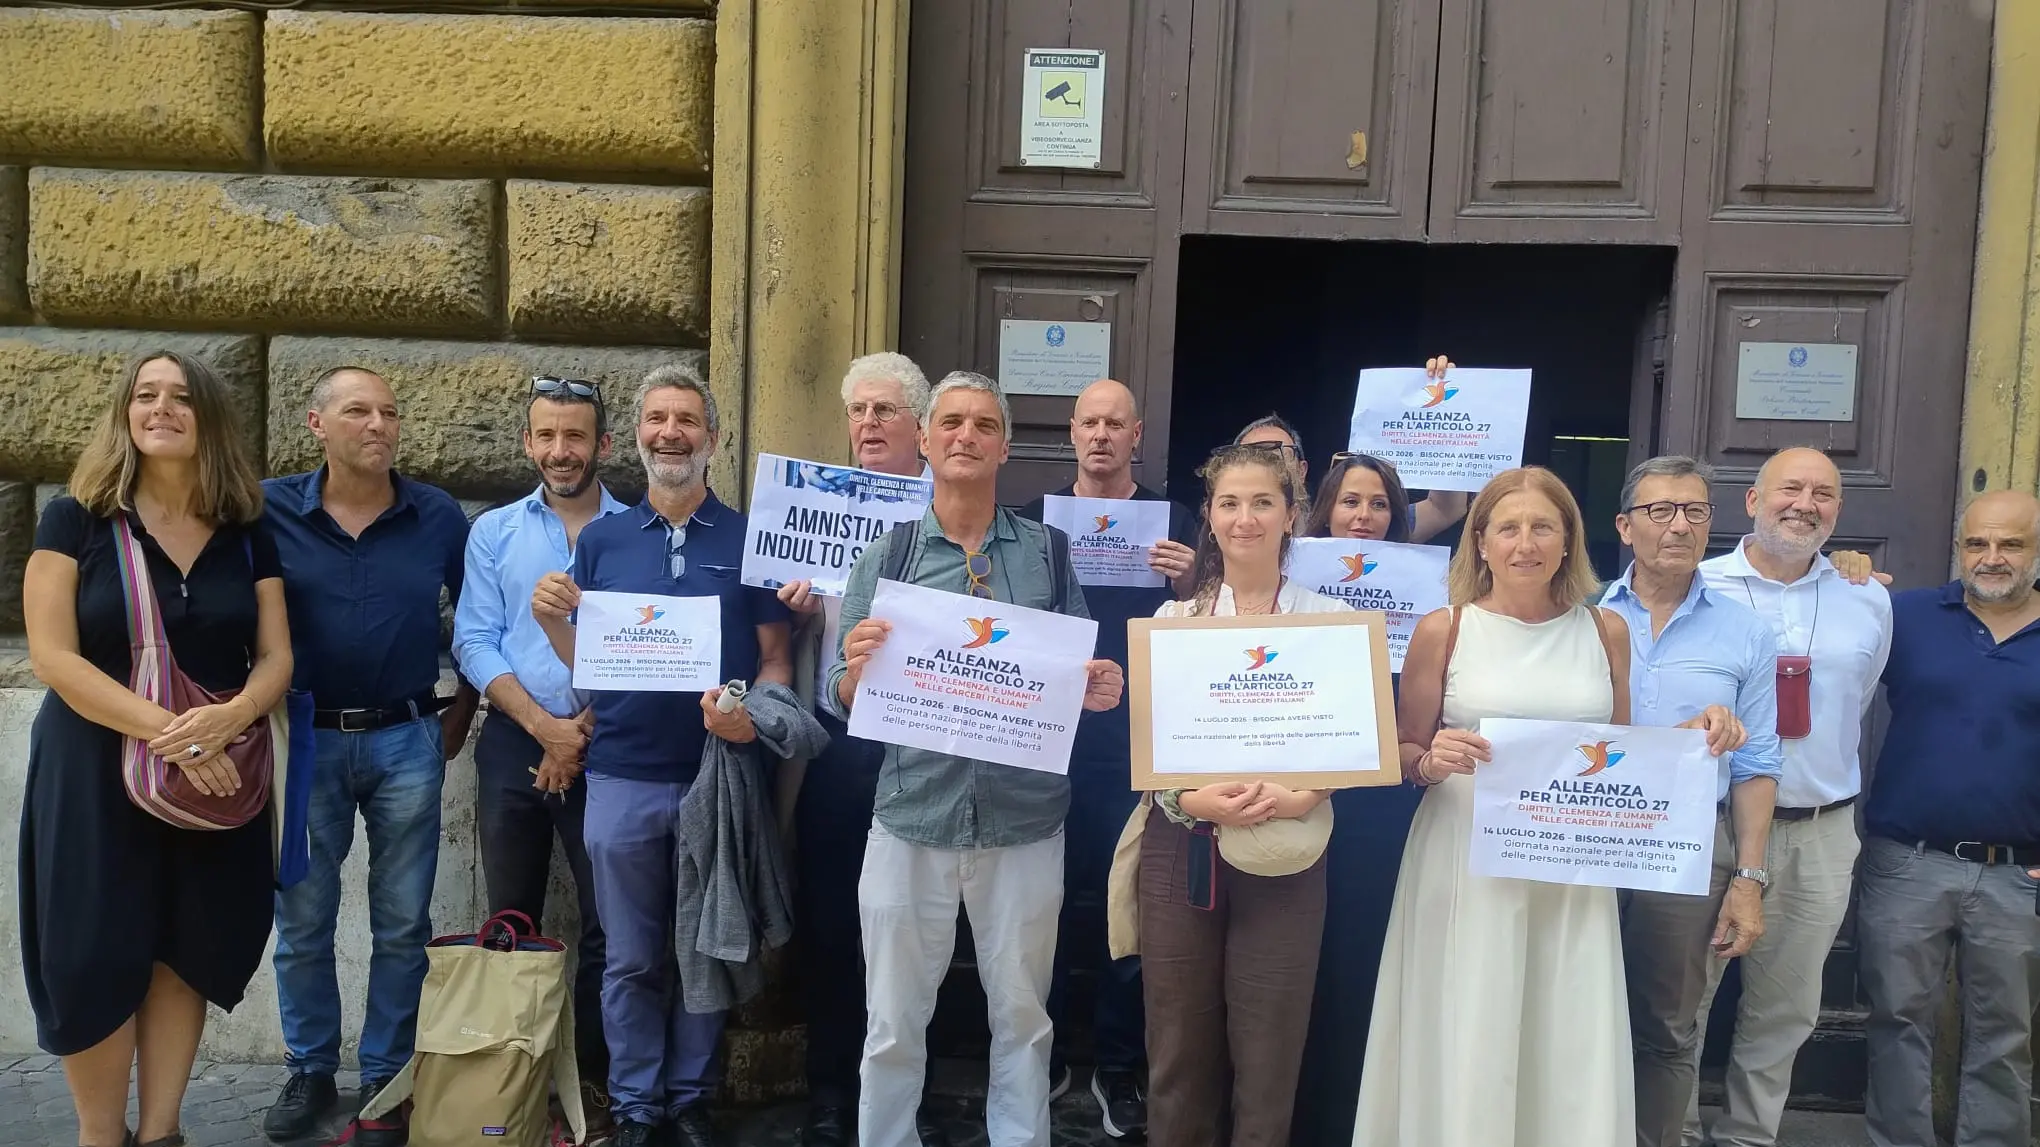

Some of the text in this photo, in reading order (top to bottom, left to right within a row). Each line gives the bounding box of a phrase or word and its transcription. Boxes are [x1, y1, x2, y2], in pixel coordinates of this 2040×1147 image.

[1033, 56, 1095, 66] ATTENZIONE!
[1402, 411, 1470, 421] ALLEANZA
[1383, 421, 1491, 432] PER L'ARTICOLO 27
[1365, 449, 1394, 457] LUGLIO
[784, 506, 884, 543] AMNISTIA
[1080, 535, 1126, 543] ALLEANZA
[756, 530, 844, 568] INDULTO
[1318, 585, 1392, 599] ALLEANZA
[619, 627, 676, 636] ALLEANZA
[624, 635, 679, 644] L'ARTICOLO
[1389, 643, 1407, 651] dign
[934, 649, 1021, 676] ALLEANZA
[904, 669, 938, 682] DIRITTI,
[941, 677, 990, 692] CLEMENZA
[907, 656, 1045, 692] PER L'ARTICOLO 27
[1229, 673, 1294, 682] ALLEANZA
[1234, 682, 1298, 690] L'ARTICOLO
[915, 681, 1028, 709] NELLE CARCERI ITALIANE
[868, 688, 1065, 732] 14 LUGLIO 2026 BISOGNA AVERE VISTO
[887, 704, 928, 718] Giornata
[931, 714, 977, 727] nazionale
[979, 723, 996, 731] per
[998, 725, 1007, 733] la
[882, 715, 906, 725] delle
[908, 721, 948, 733] persone
[950, 729, 983, 740] private
[986, 735, 1008, 745] della
[1549, 780, 1644, 797] ALLEANZA
[1520, 790, 1669, 811] PER L'ARTICOLO 27
[1559, 807, 1612, 818] CLEMENZA
[1531, 814, 1653, 830] NELLE CARCERI ITALIANE
[1497, 827, 1536, 837] LUGLIO
[1539, 831, 1565, 841] 2026
[1575, 834, 1624, 845] BISOGNA
[1627, 838, 1664, 848] AVERE
[1667, 841, 1701, 851] VISTO
[1504, 839, 1549, 850] Giornata
[1553, 846, 1603, 855] nazionale
[1625, 849, 1633, 857] la
[1501, 850, 1526, 859] delle
[1529, 855, 1574, 864] persone
[1575, 858, 1610, 867] private
[1613, 860, 1638, 869] della
